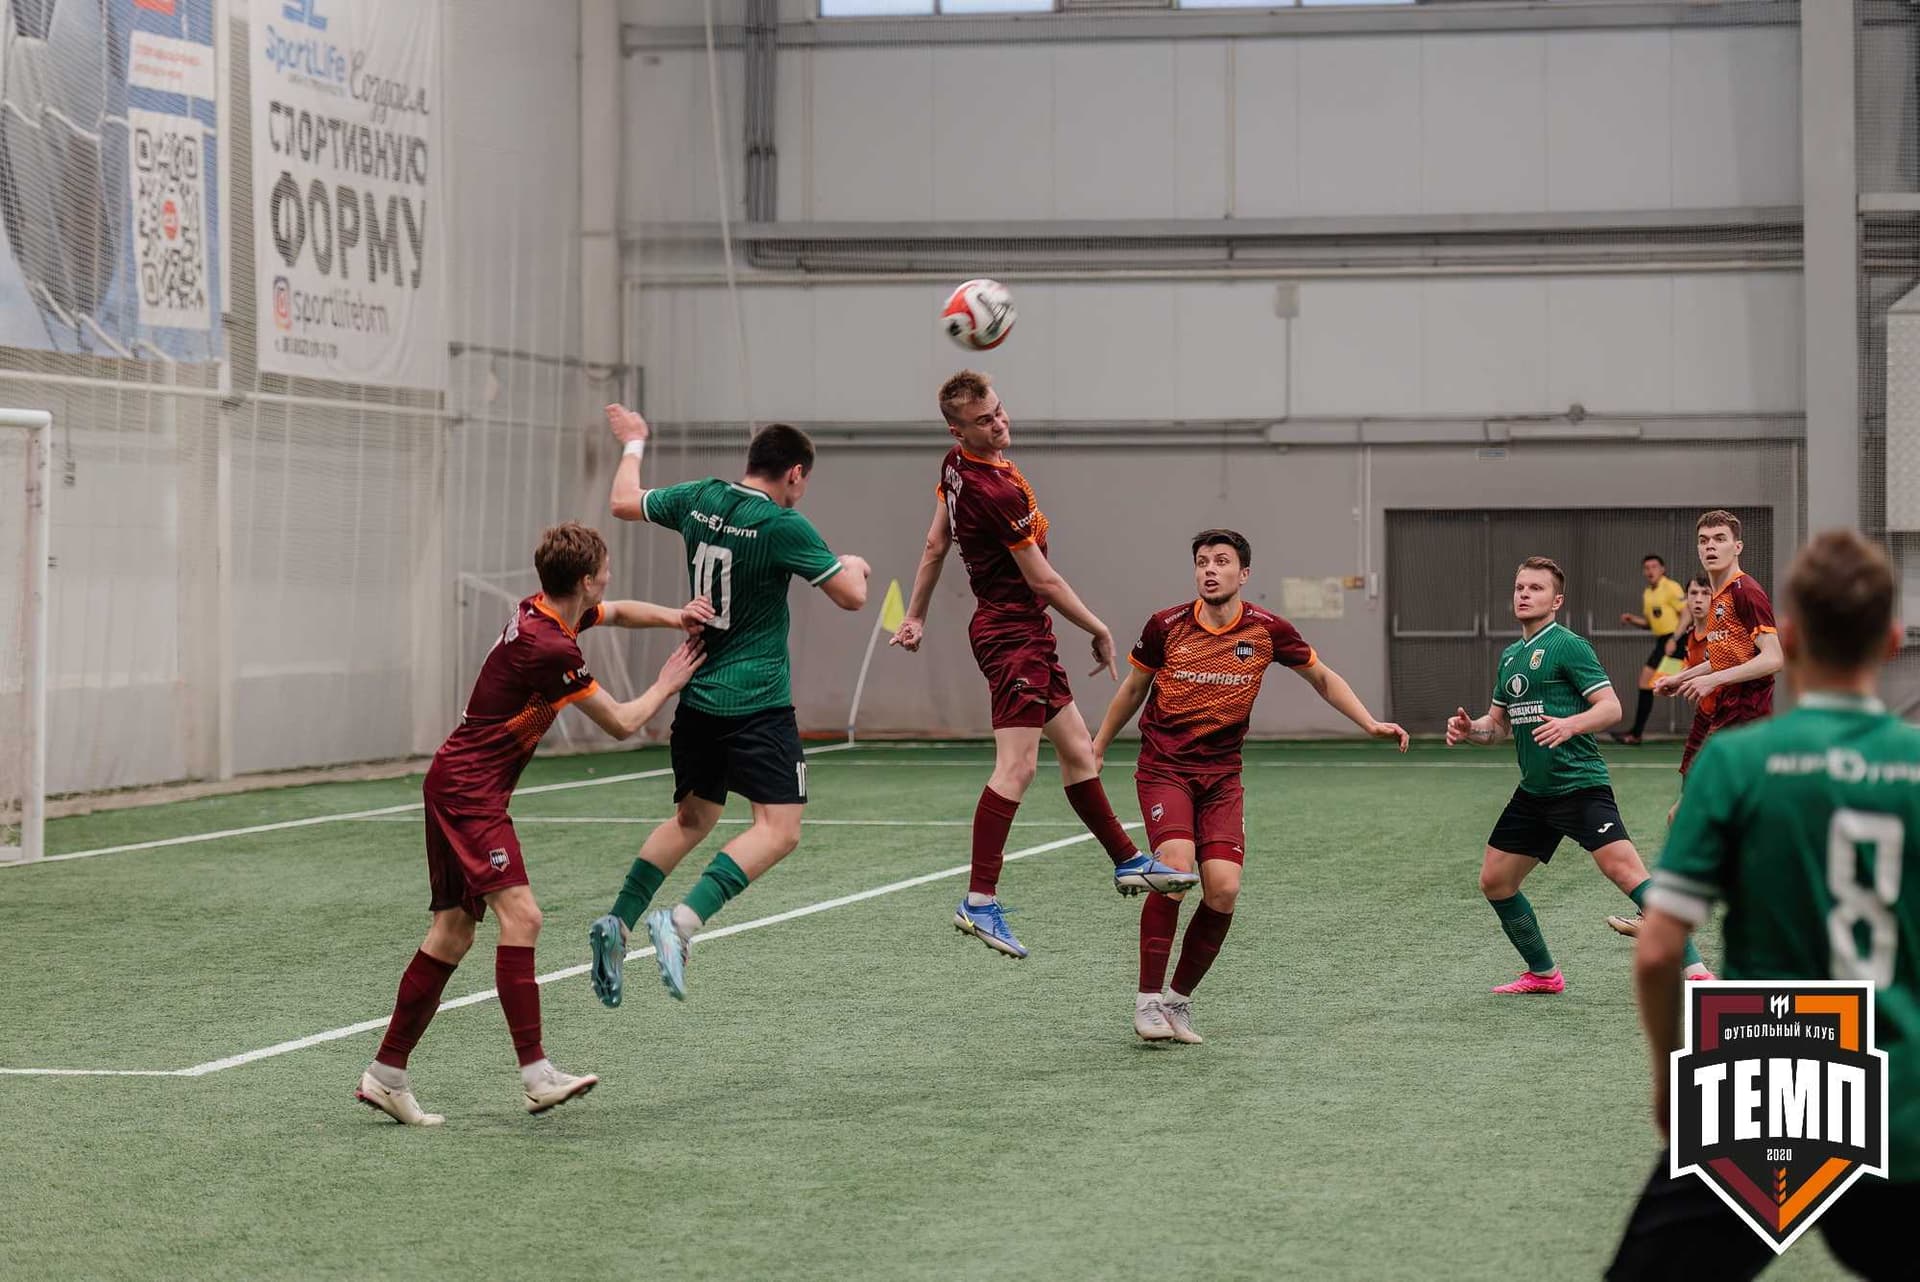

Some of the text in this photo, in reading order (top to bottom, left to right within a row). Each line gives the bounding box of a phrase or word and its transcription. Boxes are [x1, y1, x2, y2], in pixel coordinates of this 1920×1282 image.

[269, 100, 428, 186] СПОРТИВНУЮ
[270, 170, 427, 289] ФОРМУ
[692, 541, 732, 631] 10
[1826, 807, 1904, 990] 8
